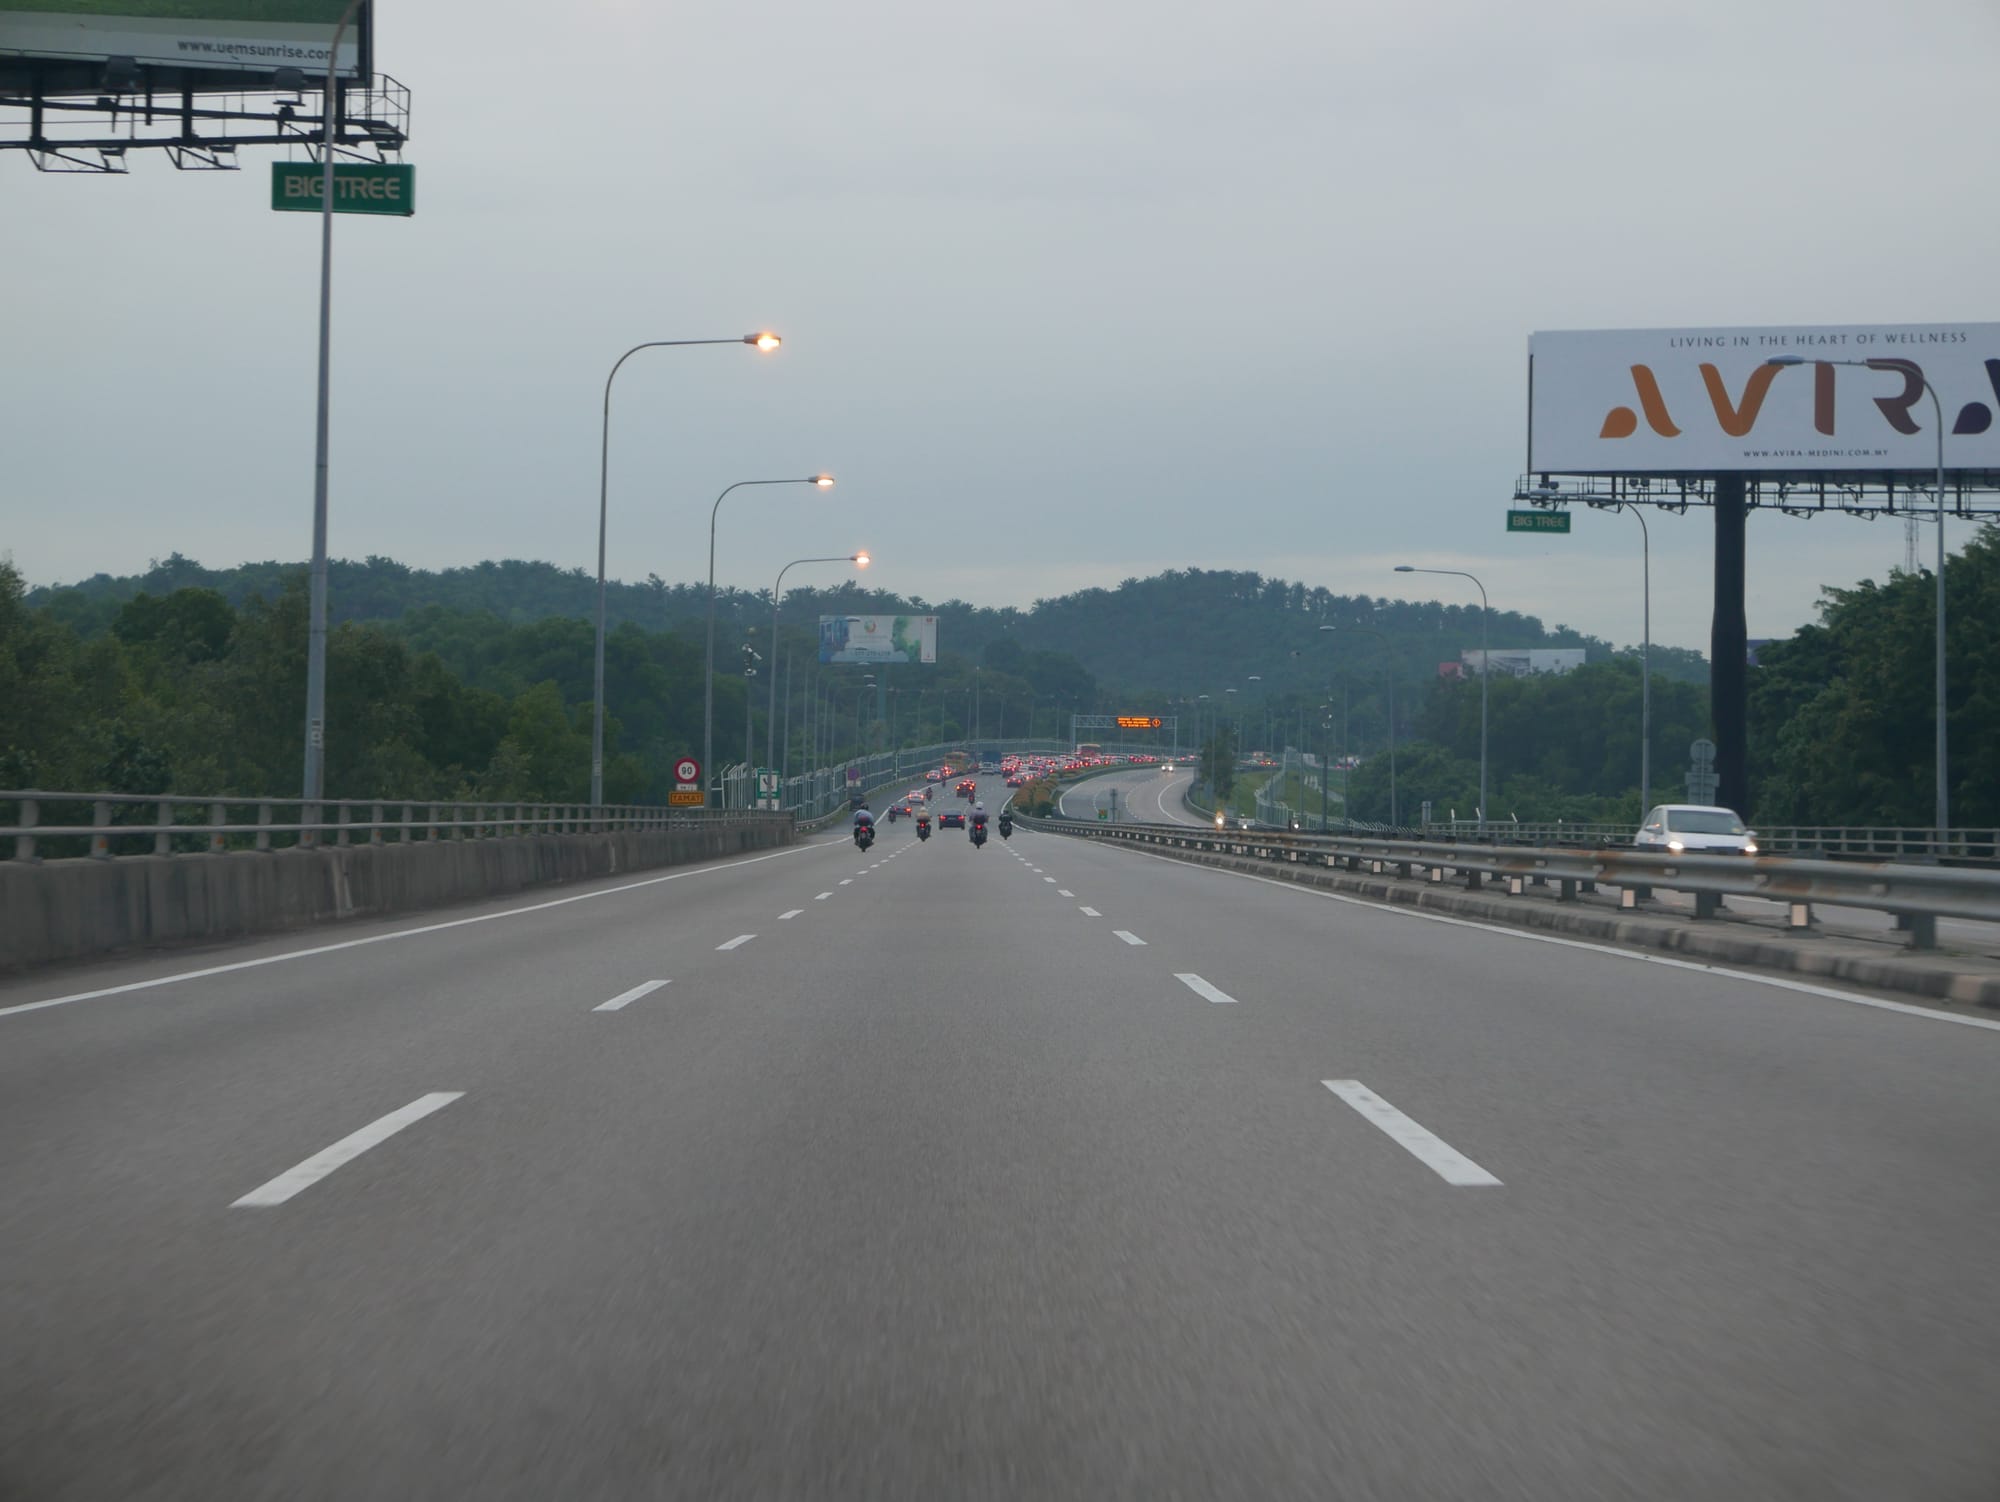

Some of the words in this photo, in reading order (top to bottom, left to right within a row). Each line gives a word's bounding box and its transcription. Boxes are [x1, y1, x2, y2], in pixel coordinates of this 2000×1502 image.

[284, 176, 325, 197] BIG
[335, 177, 400, 199] TREE
[1670, 336, 1726, 348] LIVING
[1734, 336, 1749, 346] IN
[1760, 335, 1788, 346] THE
[1796, 334, 1848, 345] HEART
[1856, 334, 1877, 344] OF
[1885, 332, 1967, 344] WELLNESS
[1512, 515, 1533, 526] BIG
[1536, 516, 1565, 528] TREE
[681, 766, 693, 775] 90
